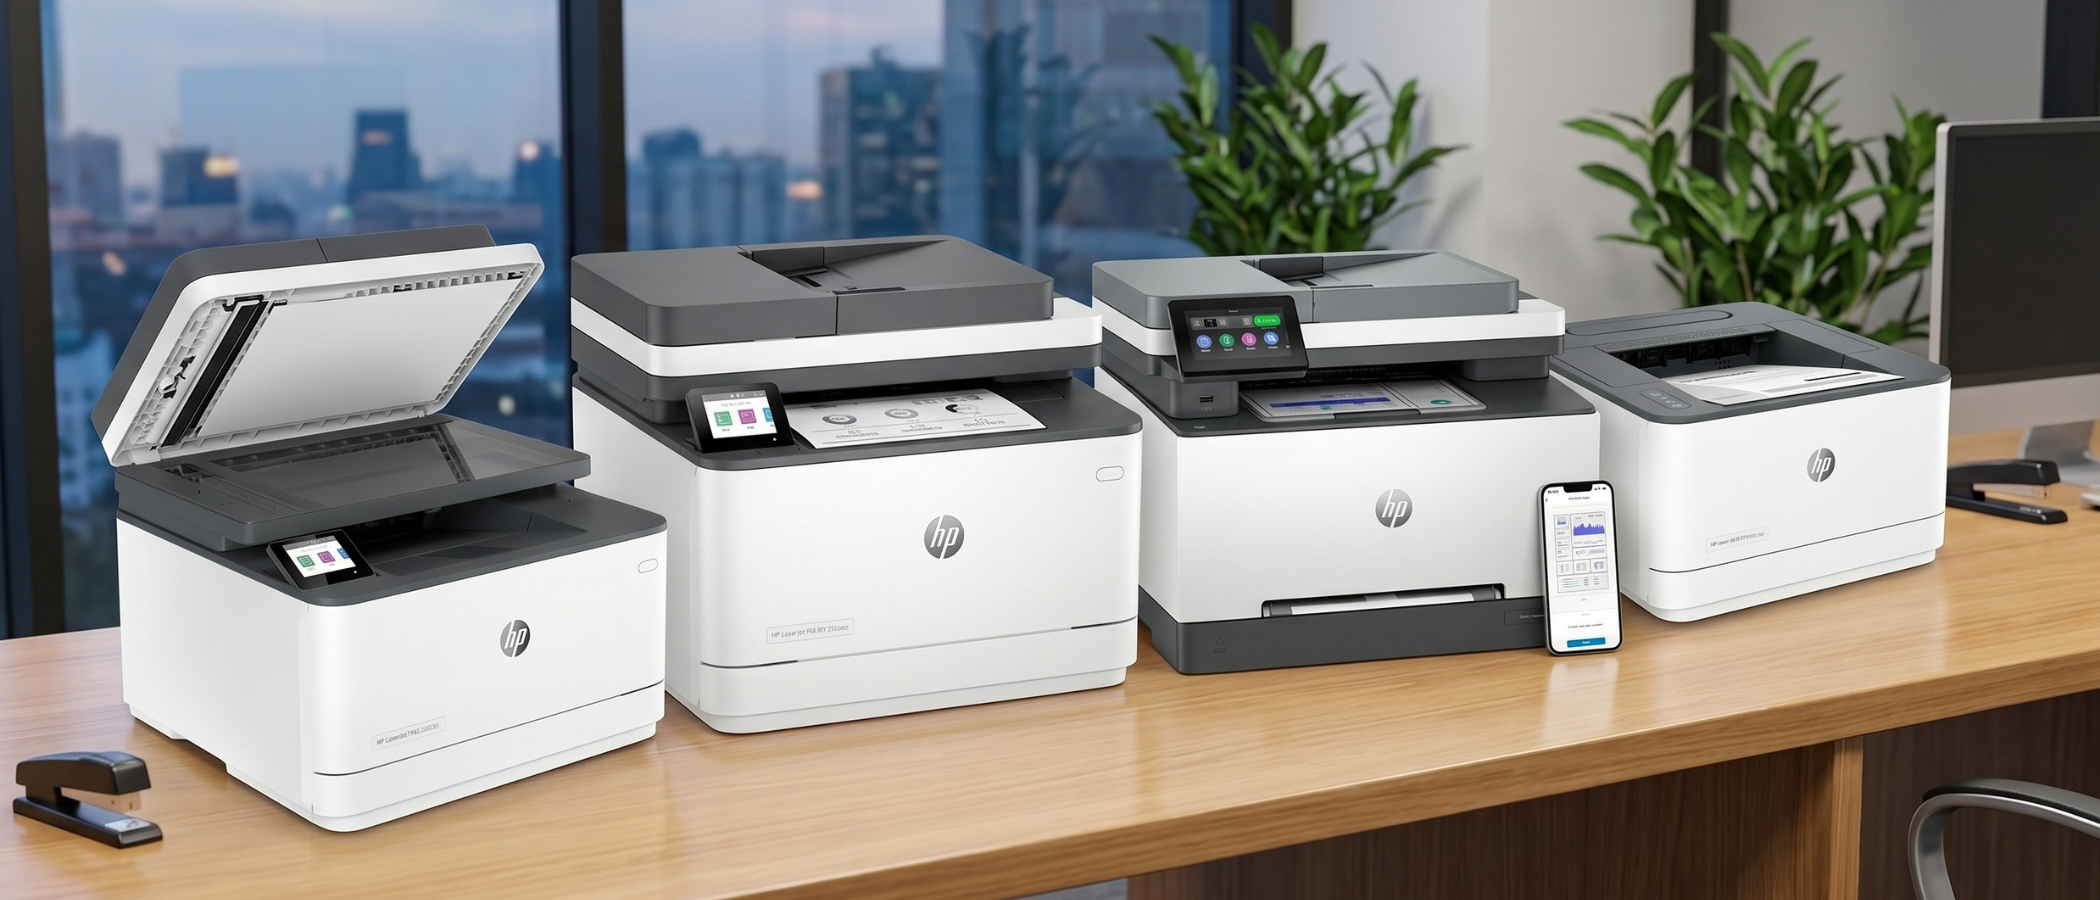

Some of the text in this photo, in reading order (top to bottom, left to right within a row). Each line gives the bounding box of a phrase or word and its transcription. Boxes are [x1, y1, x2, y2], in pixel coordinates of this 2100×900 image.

[1810, 447, 1832, 483] hp
[1381, 488, 1408, 529] hp
[929, 514, 960, 560] hp
[503, 619, 528, 658] hp
